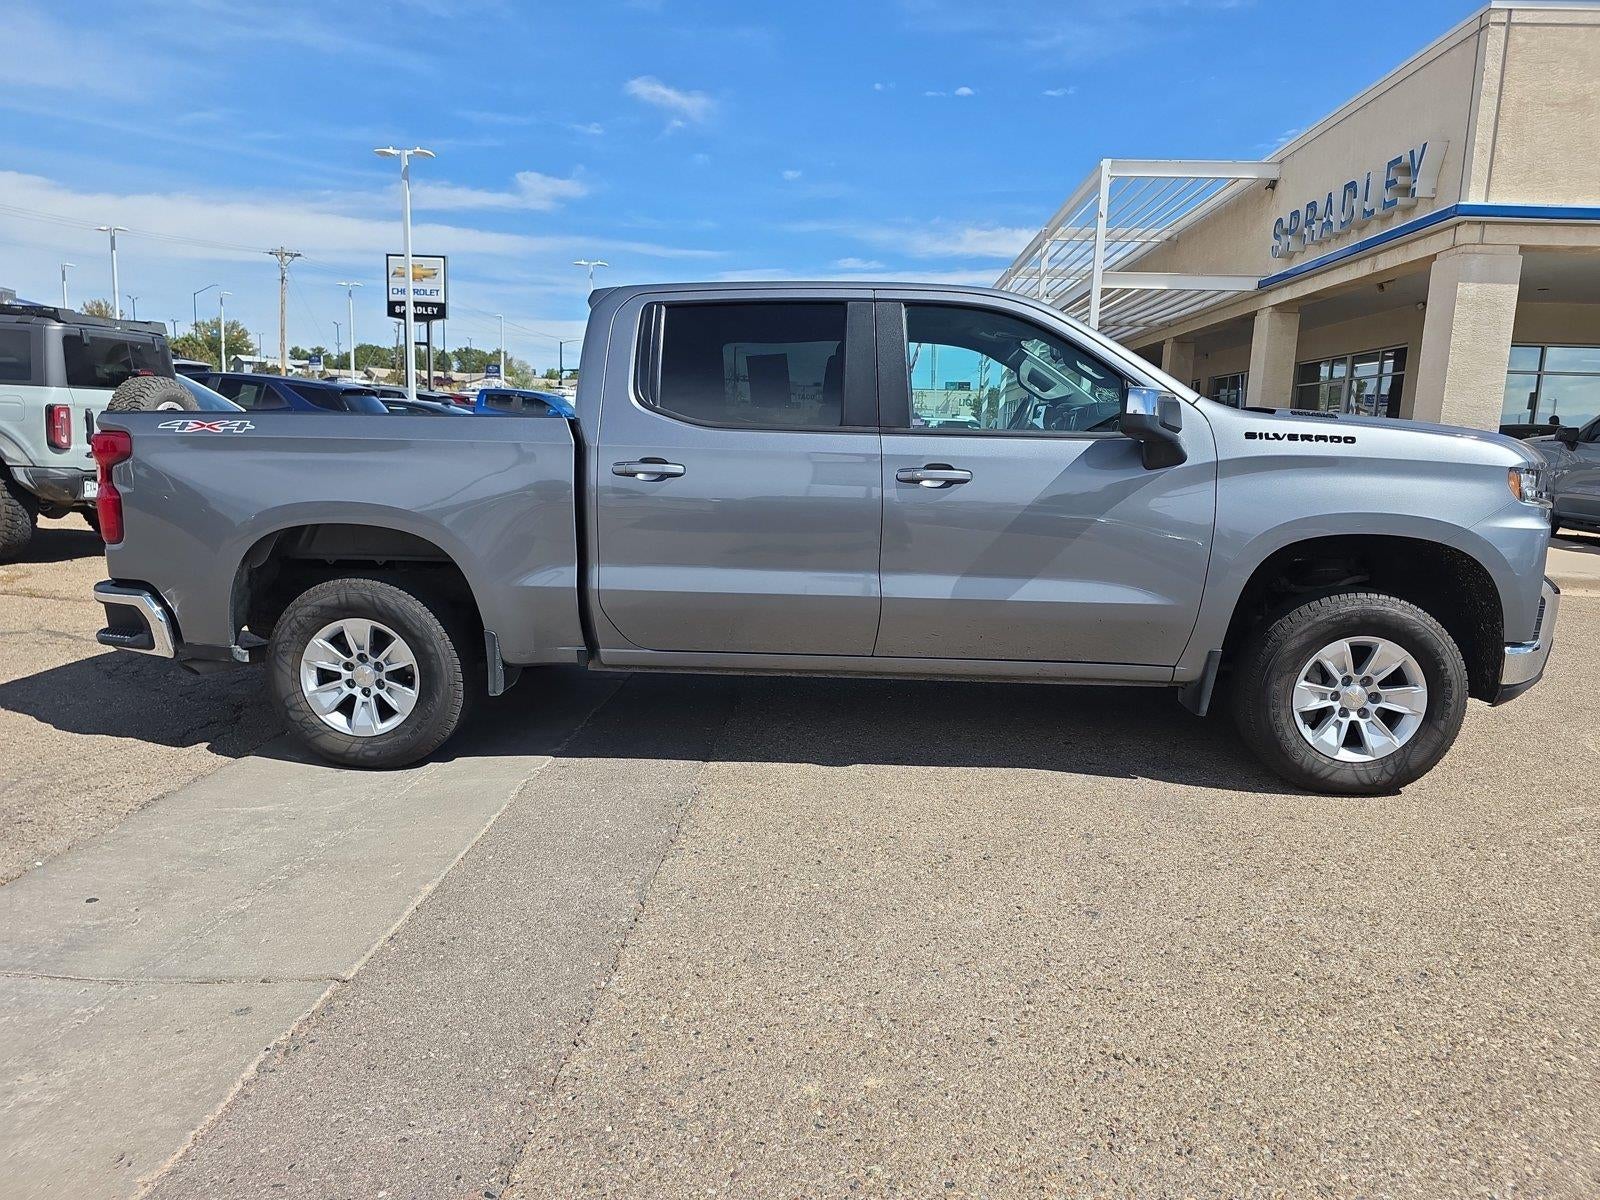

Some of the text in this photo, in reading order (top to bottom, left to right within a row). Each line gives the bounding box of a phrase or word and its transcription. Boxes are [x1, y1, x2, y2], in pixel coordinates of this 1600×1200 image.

[1271, 140, 1430, 259] SPRADLEY
[391, 287, 440, 297] CHEROLET
[394, 305, 439, 315] SPADLEY
[1244, 431, 1357, 444] SILVERADO
